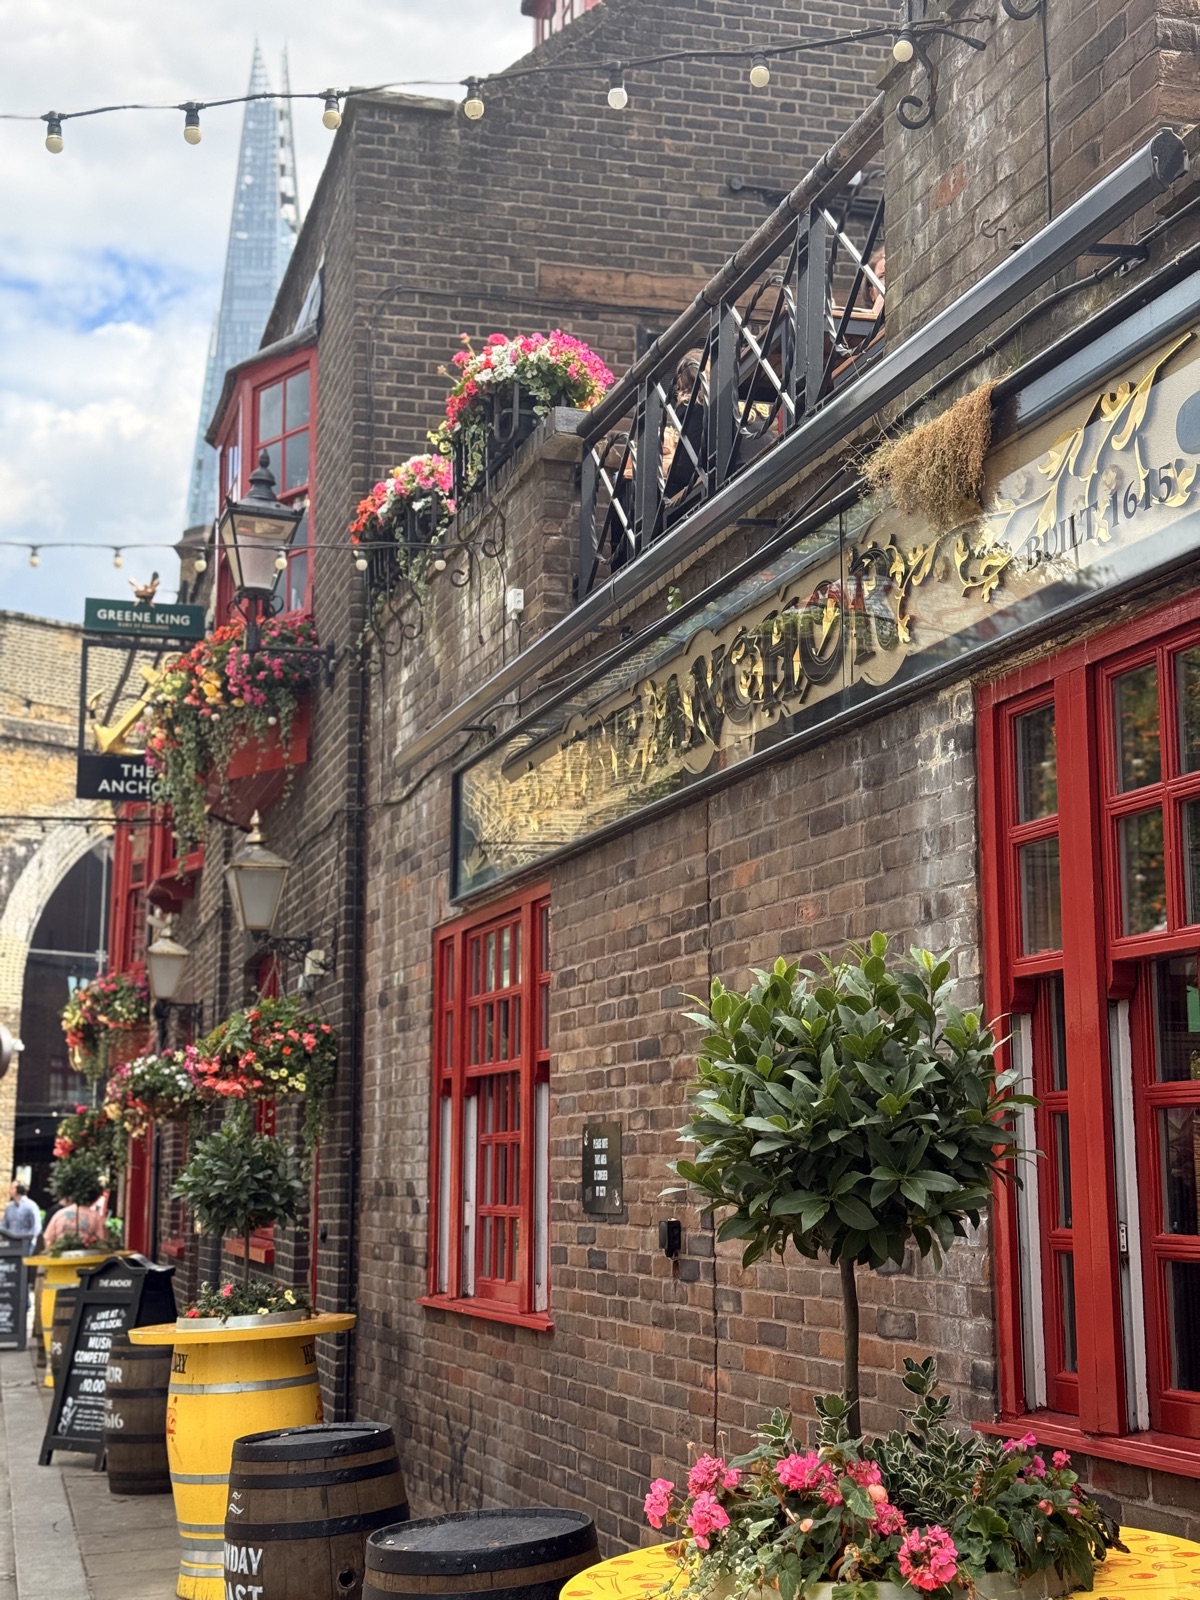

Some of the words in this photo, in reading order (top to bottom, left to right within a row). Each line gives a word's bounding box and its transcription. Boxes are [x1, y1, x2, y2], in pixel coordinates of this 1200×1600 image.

[1024, 501, 1098, 572] BUILT
[1109, 461, 1176, 528] 1615
[97, 608, 151, 623] GREENE
[155, 612, 191, 626] KING
[648, 546, 898, 768] ANCHOR
[120, 763, 155, 778] THE
[96, 1310, 110, 1320] LIVE
[110, 1309, 120, 1319] AT
[90, 1320, 106, 1331] YOUR
[105, 1319, 123, 1329] LOCAL
[225, 1582, 263, 1600] AST
